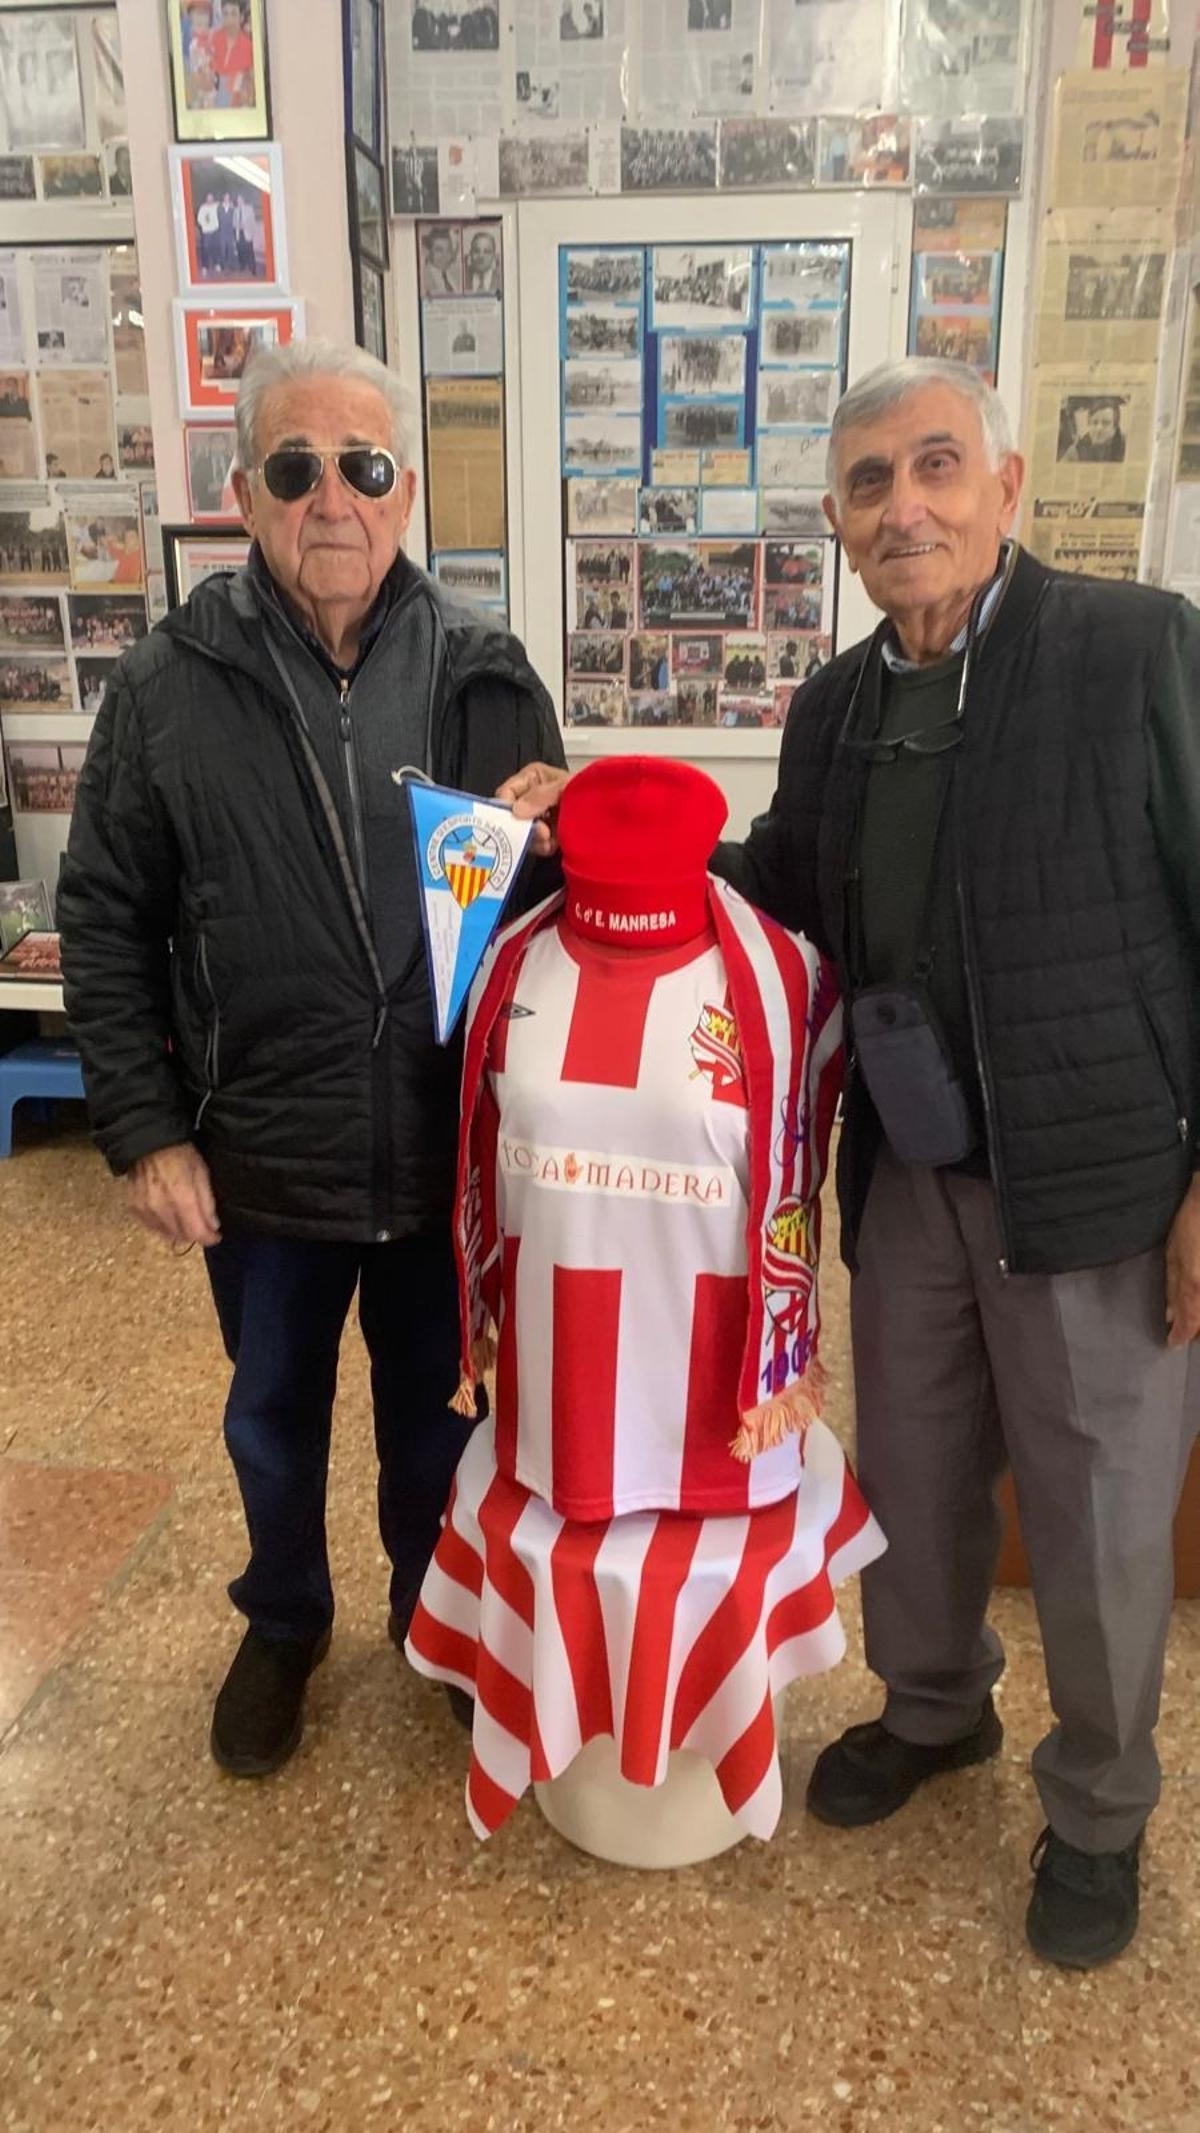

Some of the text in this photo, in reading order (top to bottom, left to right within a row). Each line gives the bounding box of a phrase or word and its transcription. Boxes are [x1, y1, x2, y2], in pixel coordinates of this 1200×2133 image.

[595, 909, 605, 928] E.
[609, 909, 677, 932] MANRESA
[586, 1160, 723, 1205] MADERA
